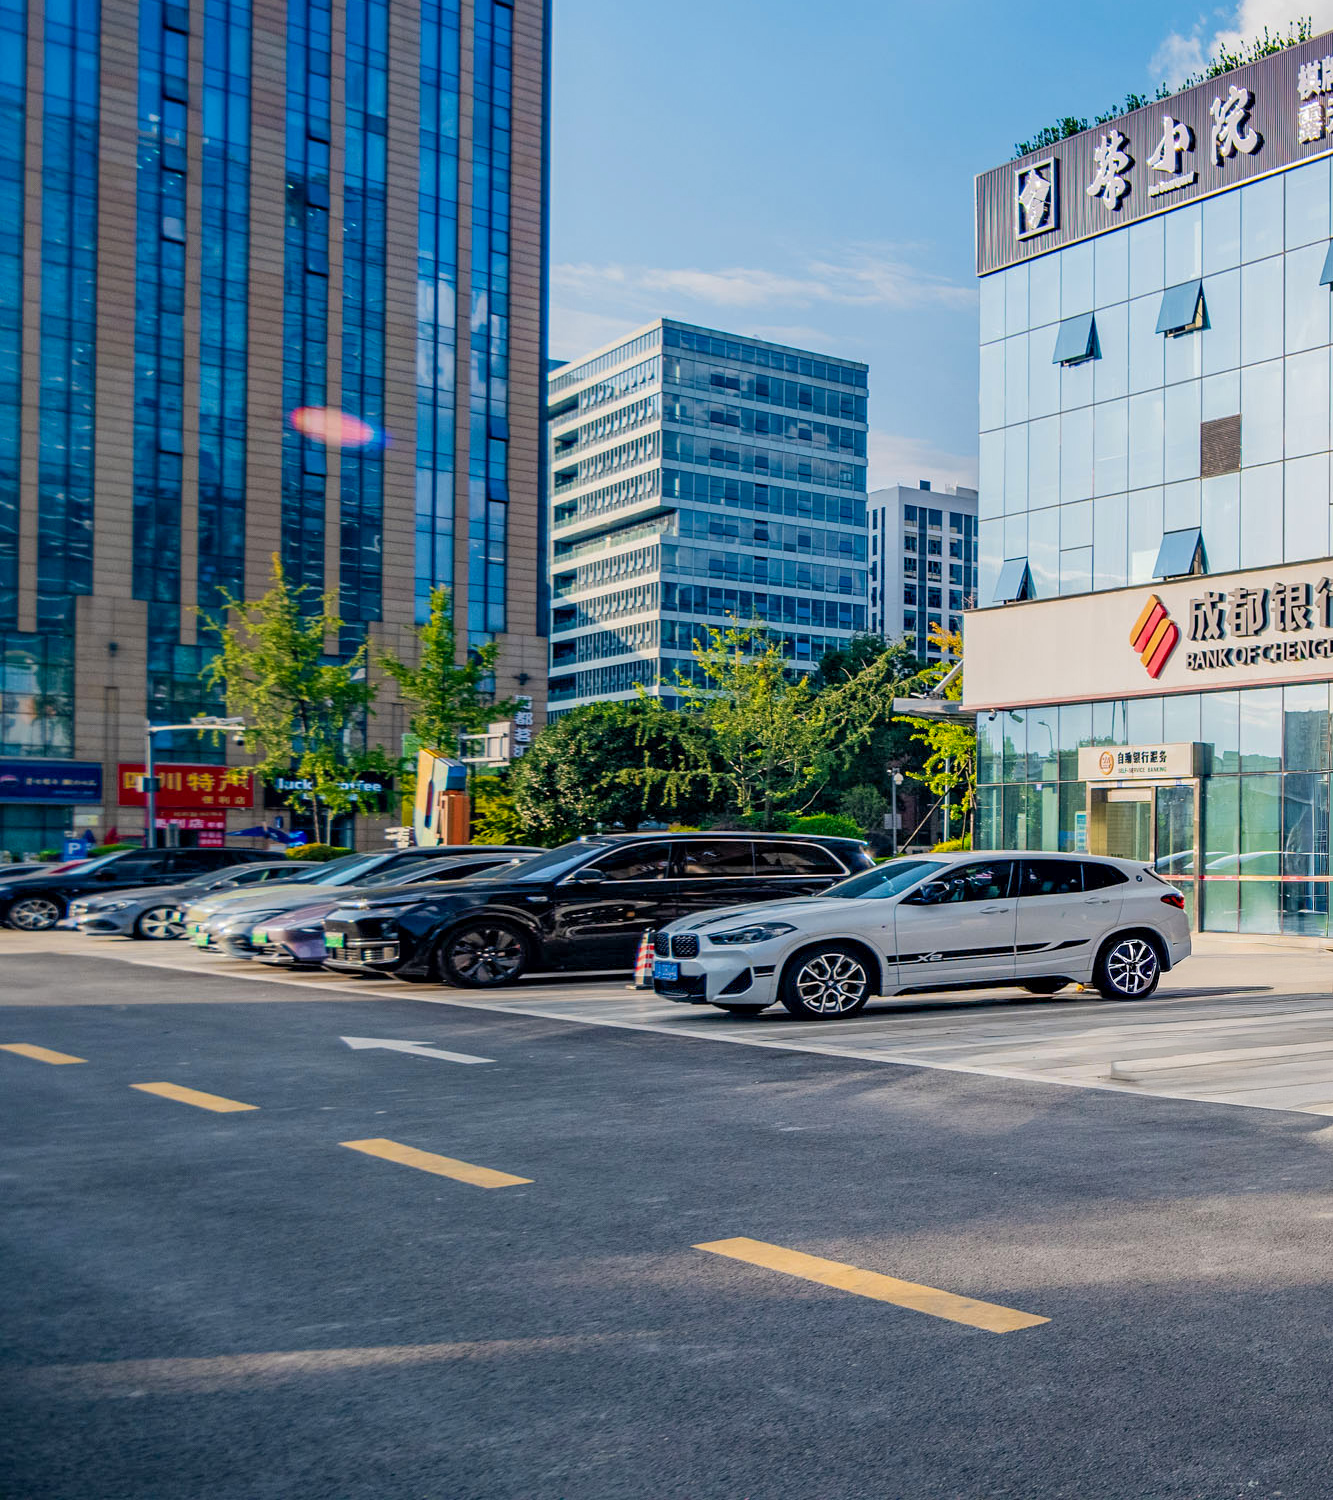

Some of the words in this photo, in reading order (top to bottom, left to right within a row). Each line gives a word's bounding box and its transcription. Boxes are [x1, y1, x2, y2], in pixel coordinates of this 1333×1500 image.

[1185, 648, 1233, 671] BANK
[1233, 644, 1261, 666] OF
[68, 842, 81, 855] P
[917, 950, 944, 962] X2
